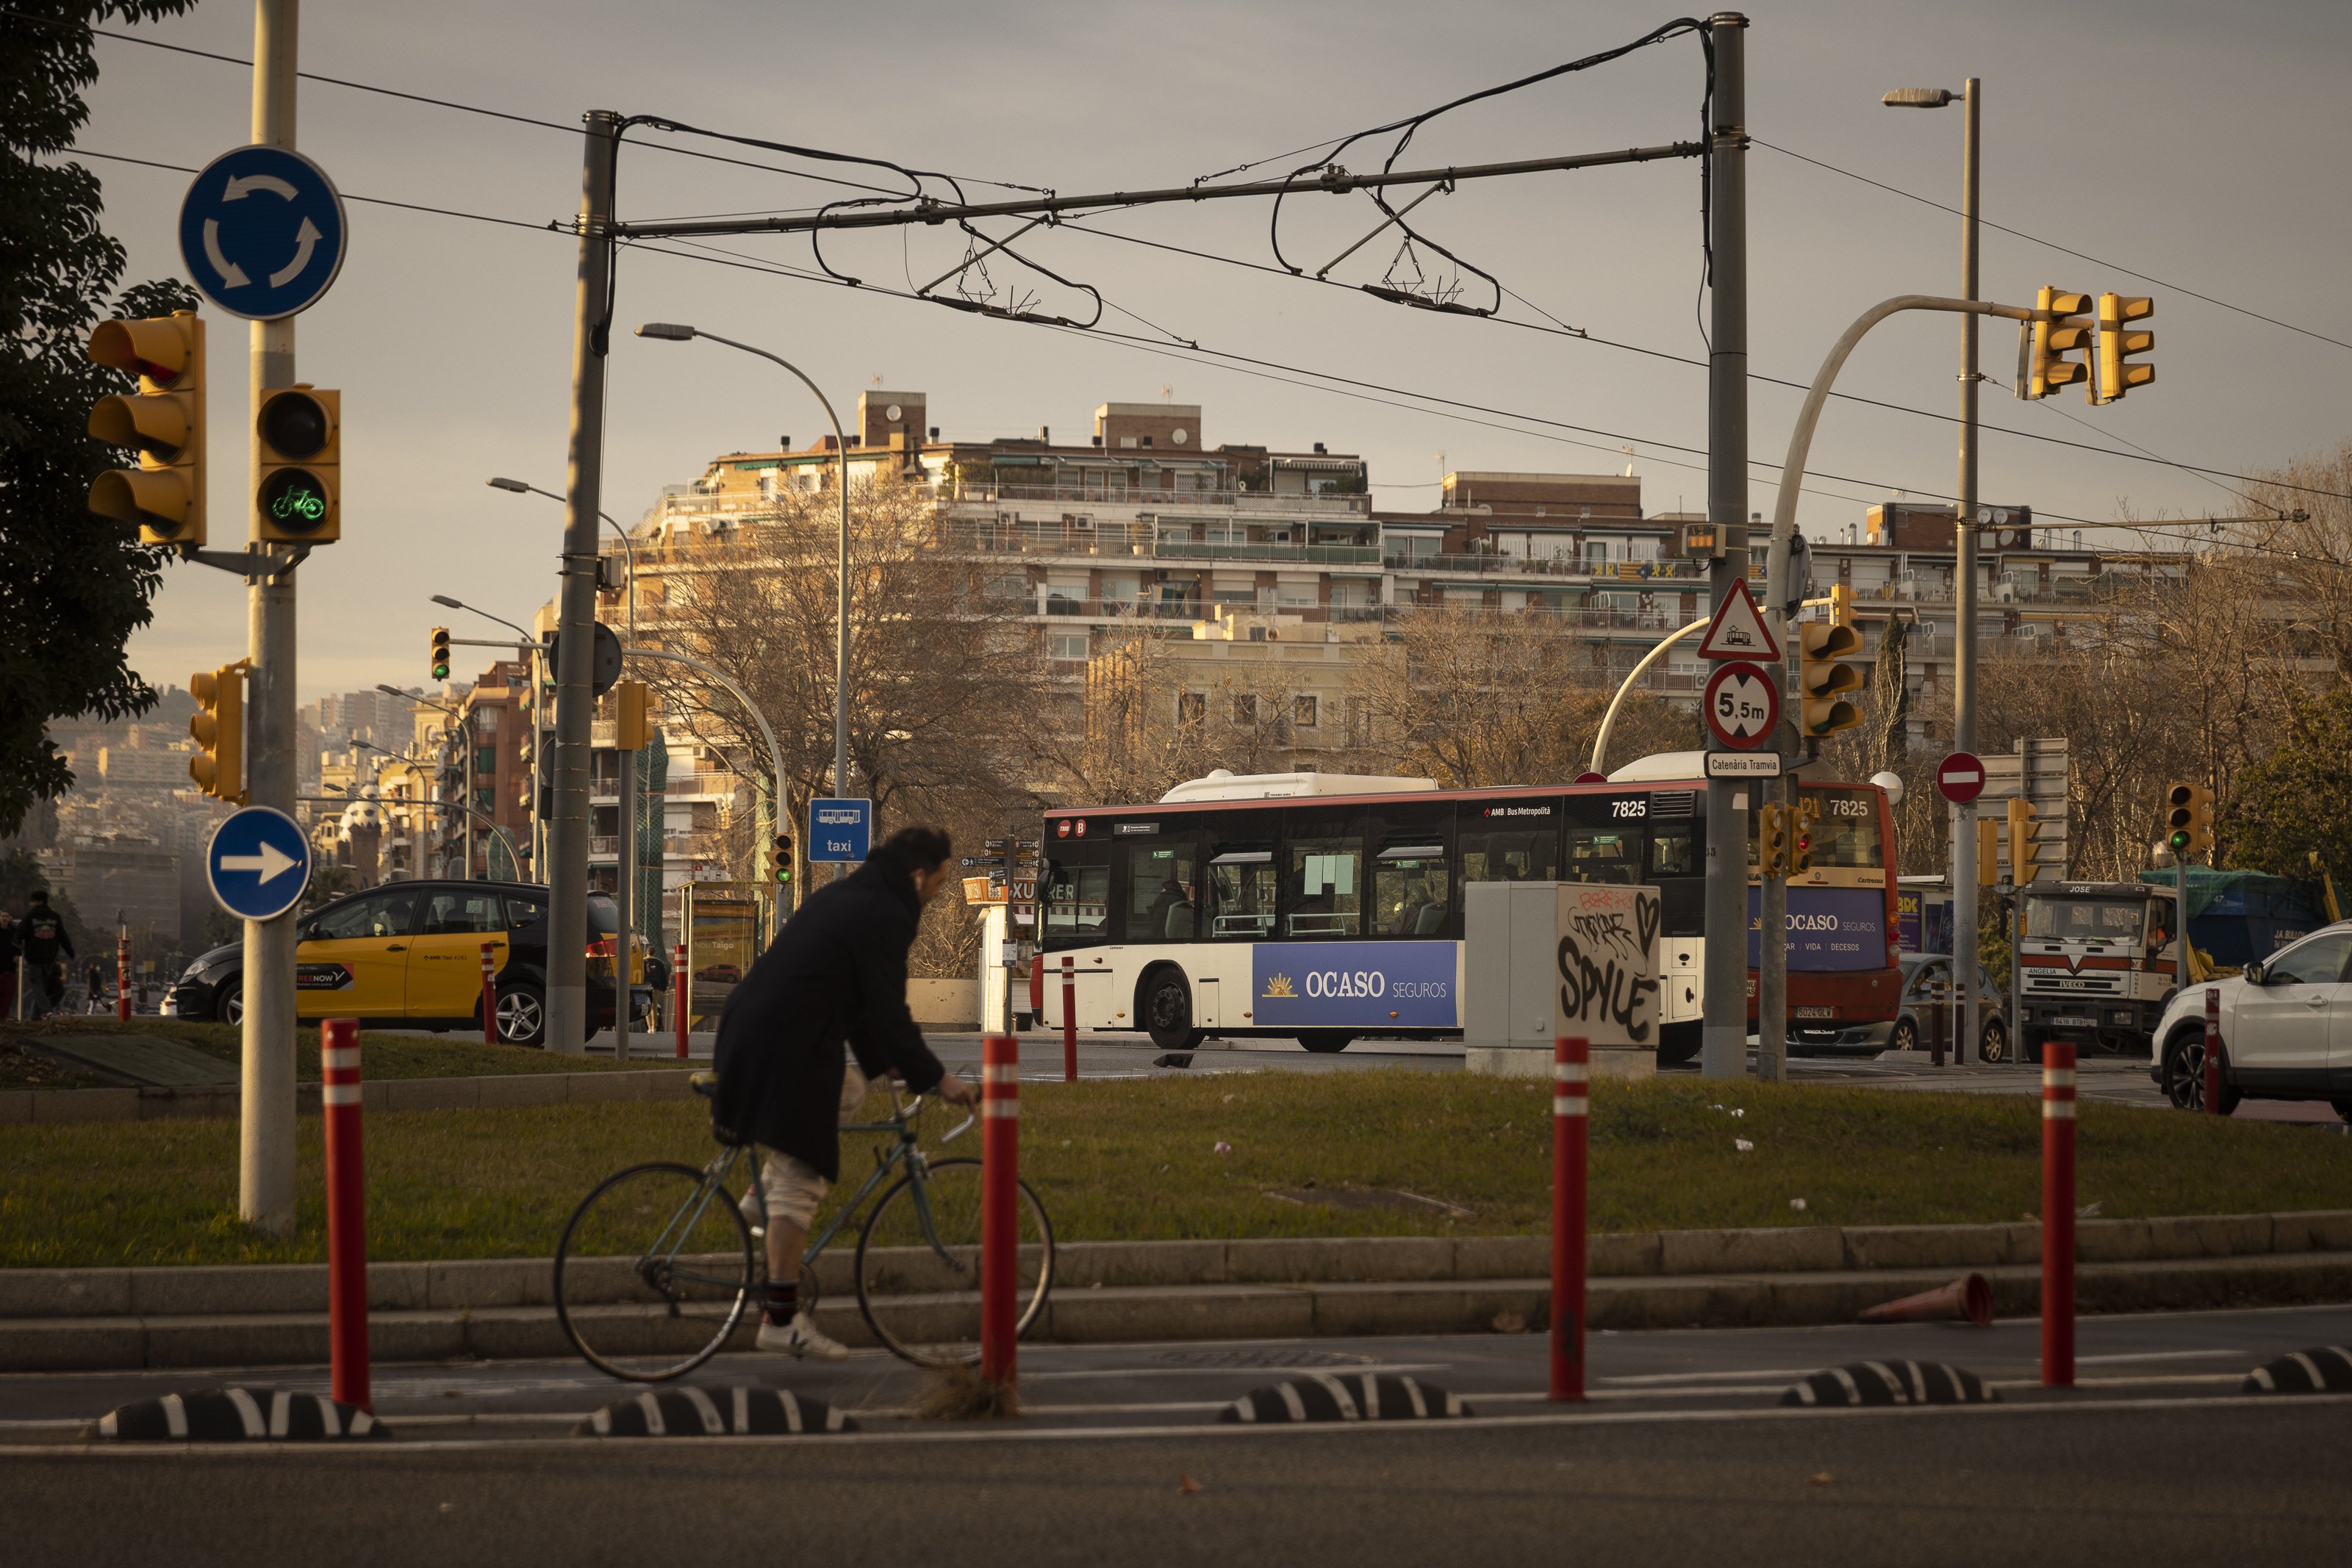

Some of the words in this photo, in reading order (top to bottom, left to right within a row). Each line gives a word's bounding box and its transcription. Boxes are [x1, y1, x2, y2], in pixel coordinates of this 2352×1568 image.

[1718, 692, 1764, 719] 5,5m
[1712, 758, 1747, 770] Catenària
[1749, 759, 1776, 770] Tramvia
[1491, 808, 1505, 816] AMB
[1507, 808, 1518, 816] Bus
[1518, 806, 1550, 816] Metropolità
[1612, 801, 1646, 817] 7825
[1830, 799, 1868, 816] 7825
[1078, 822, 1084, 832] B
[827, 840, 852, 852] taxi
[1785, 915, 1838, 931] OCASO
[1843, 921, 1876, 932] SEGUROS
[712, 941, 734, 951] Taigo
[1805, 943, 1821, 951] VIDA
[1831, 943, 1860, 952] DECESOS
[1305, 971, 1385, 998] OCASO
[1393, 982, 1446, 998] SEGUROS
[2059, 980, 2085, 988] IVECO
[1799, 1007, 1816, 1017] 5024
